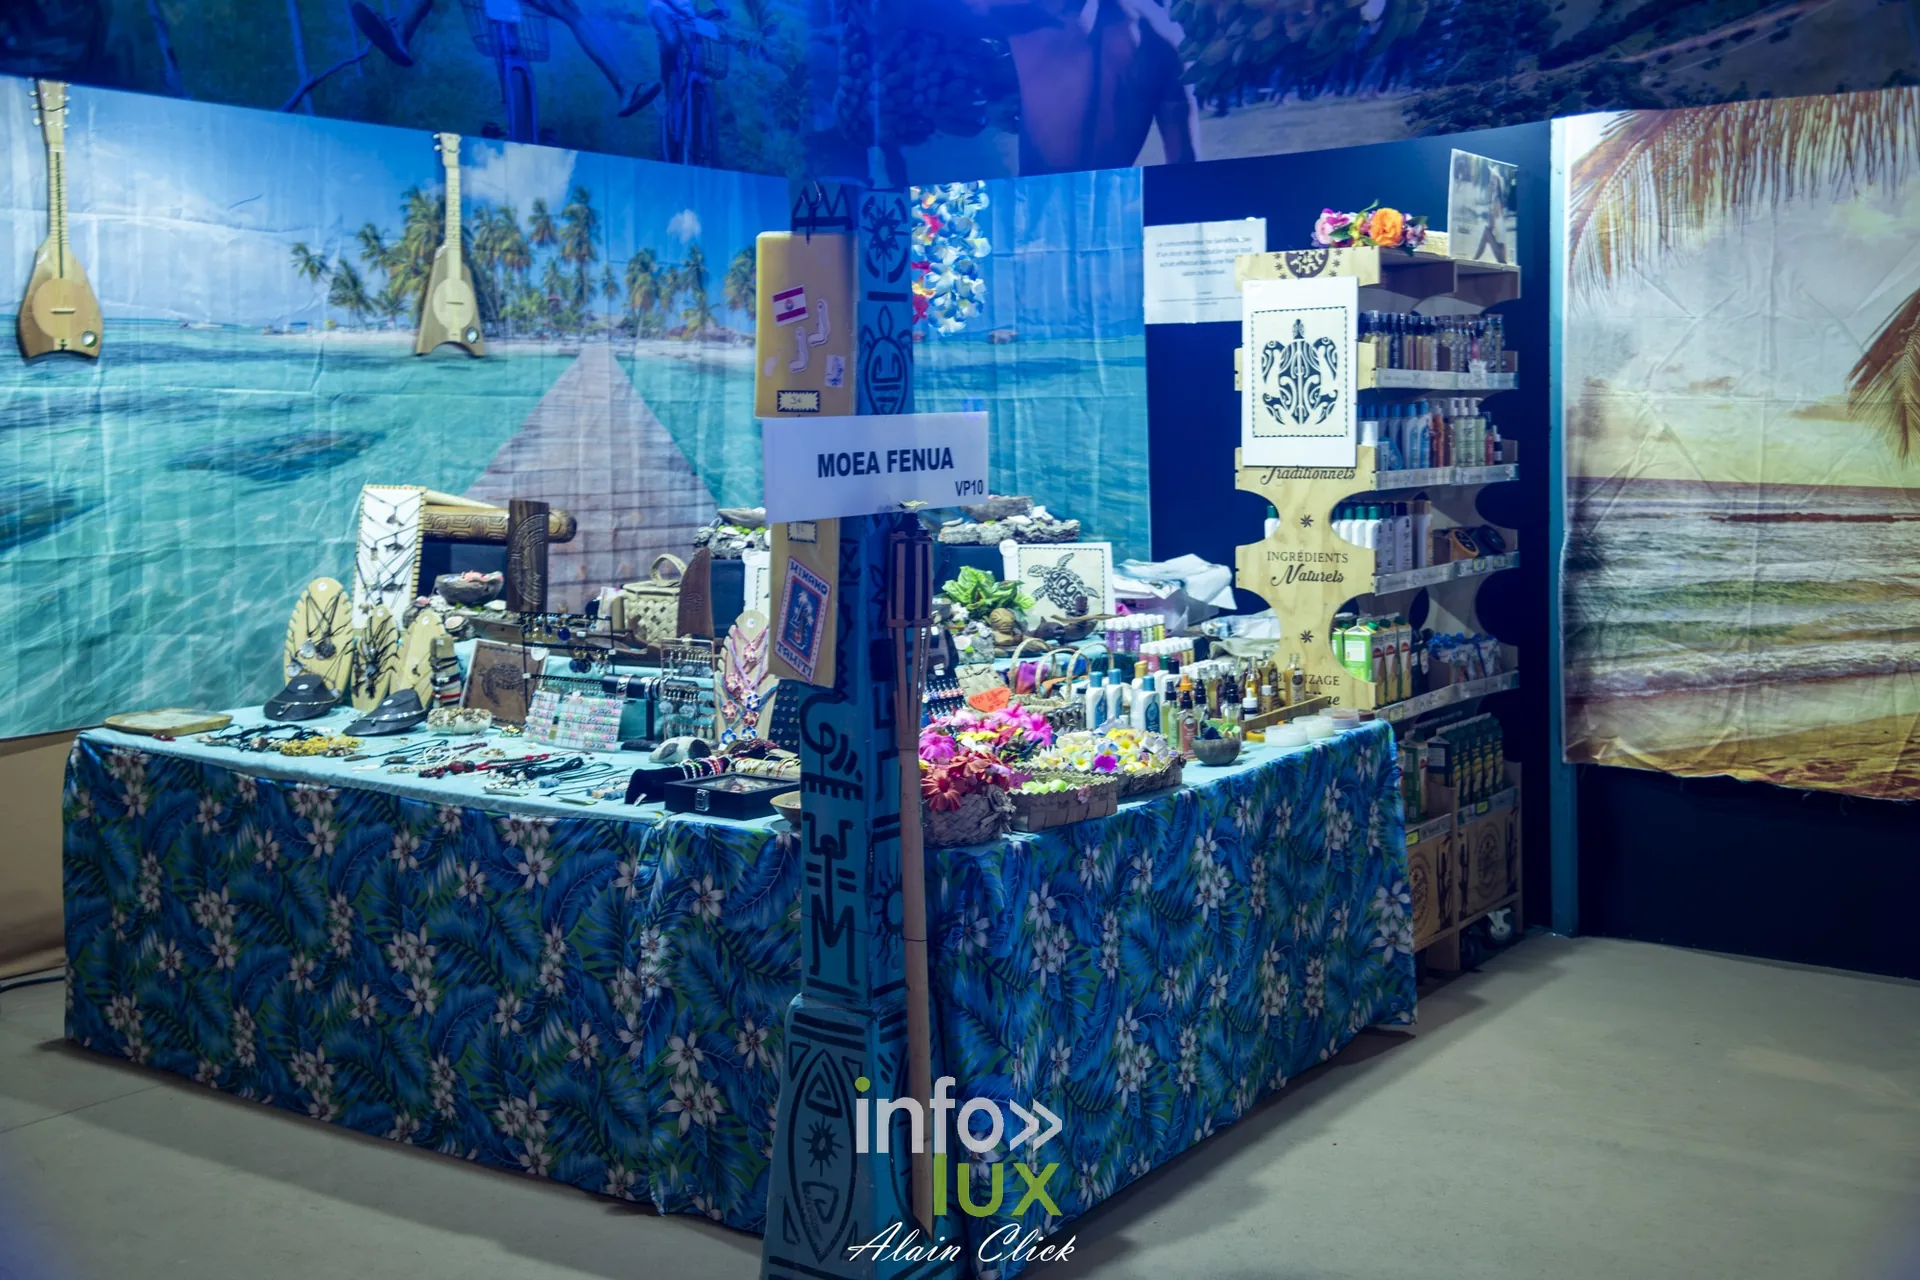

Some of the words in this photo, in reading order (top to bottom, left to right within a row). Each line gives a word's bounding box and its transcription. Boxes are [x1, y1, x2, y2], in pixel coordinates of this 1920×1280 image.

[817, 450, 880, 479] MOEA
[886, 446, 955, 474] FENUA
[954, 478, 984, 497] VP10
[1267, 550, 1349, 564] INGRÉDIENTS
[790, 561, 828, 596] HINANO
[1269, 563, 1344, 587] Naturels
[776, 641, 813, 677] TAHITI
